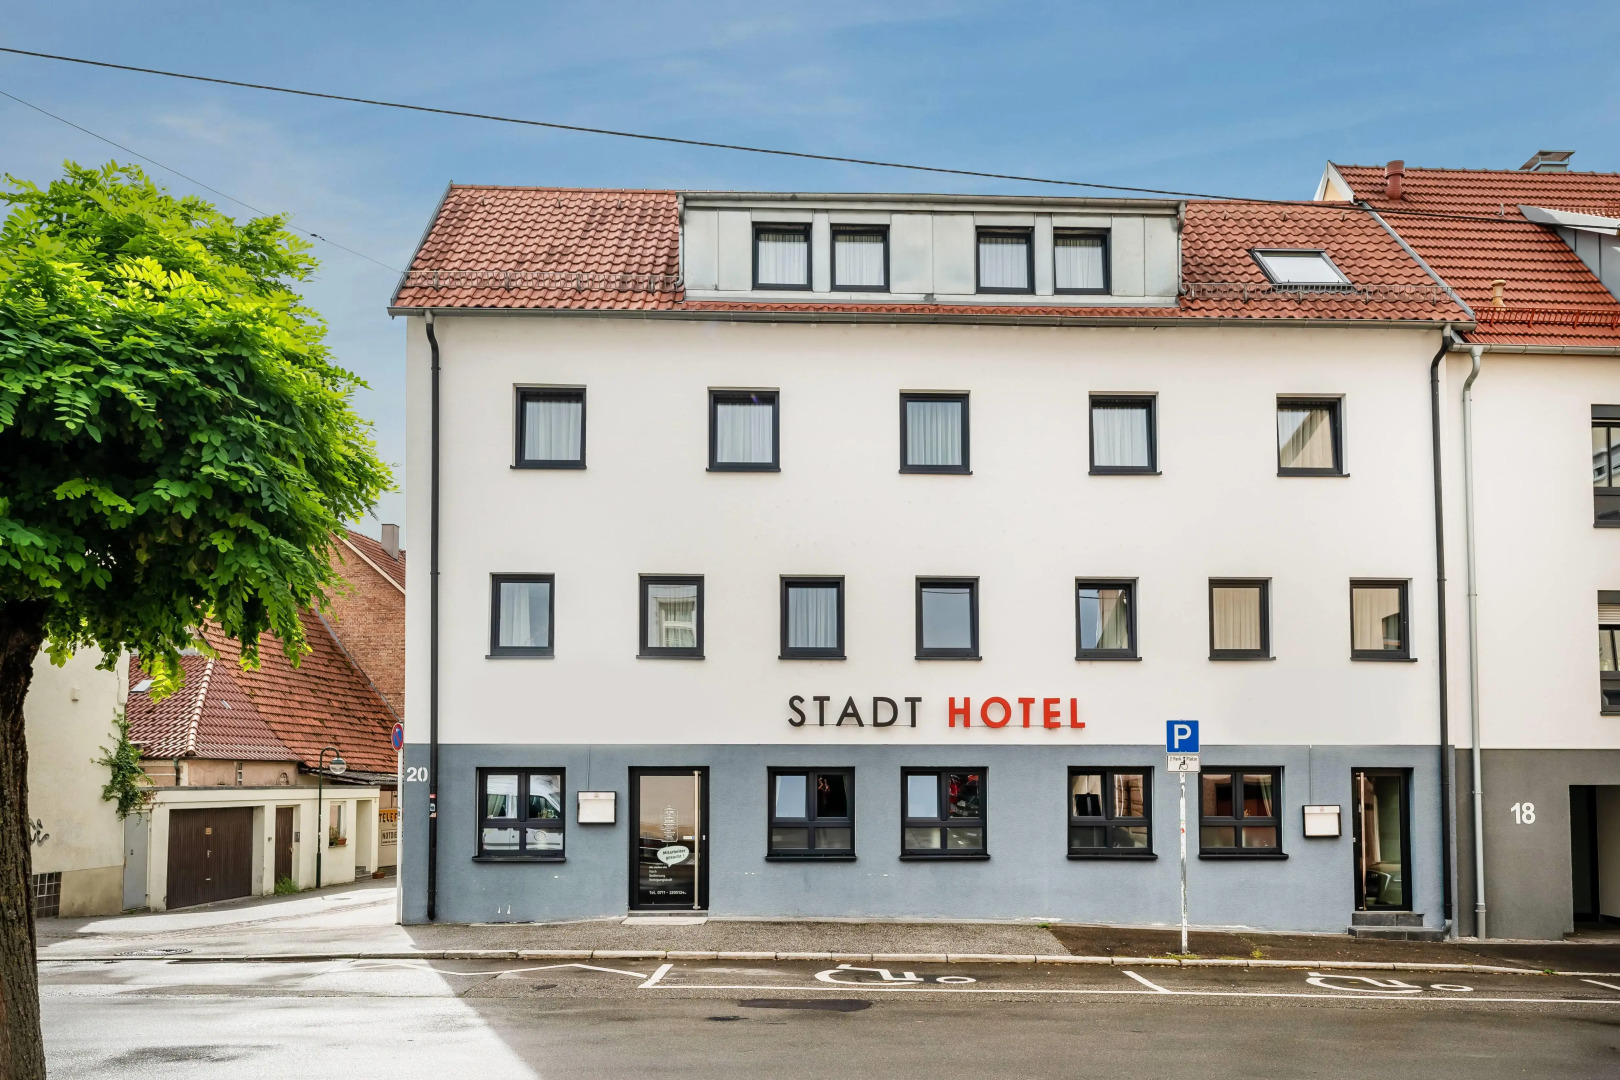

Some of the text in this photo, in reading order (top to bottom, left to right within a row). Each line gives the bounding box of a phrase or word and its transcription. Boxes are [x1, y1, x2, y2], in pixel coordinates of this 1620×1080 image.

[787, 694, 1086, 729] STADT HOTEL
[1174, 724, 1192, 749] P
[406, 766, 428, 782] 20
[1510, 802, 1536, 825] 18
